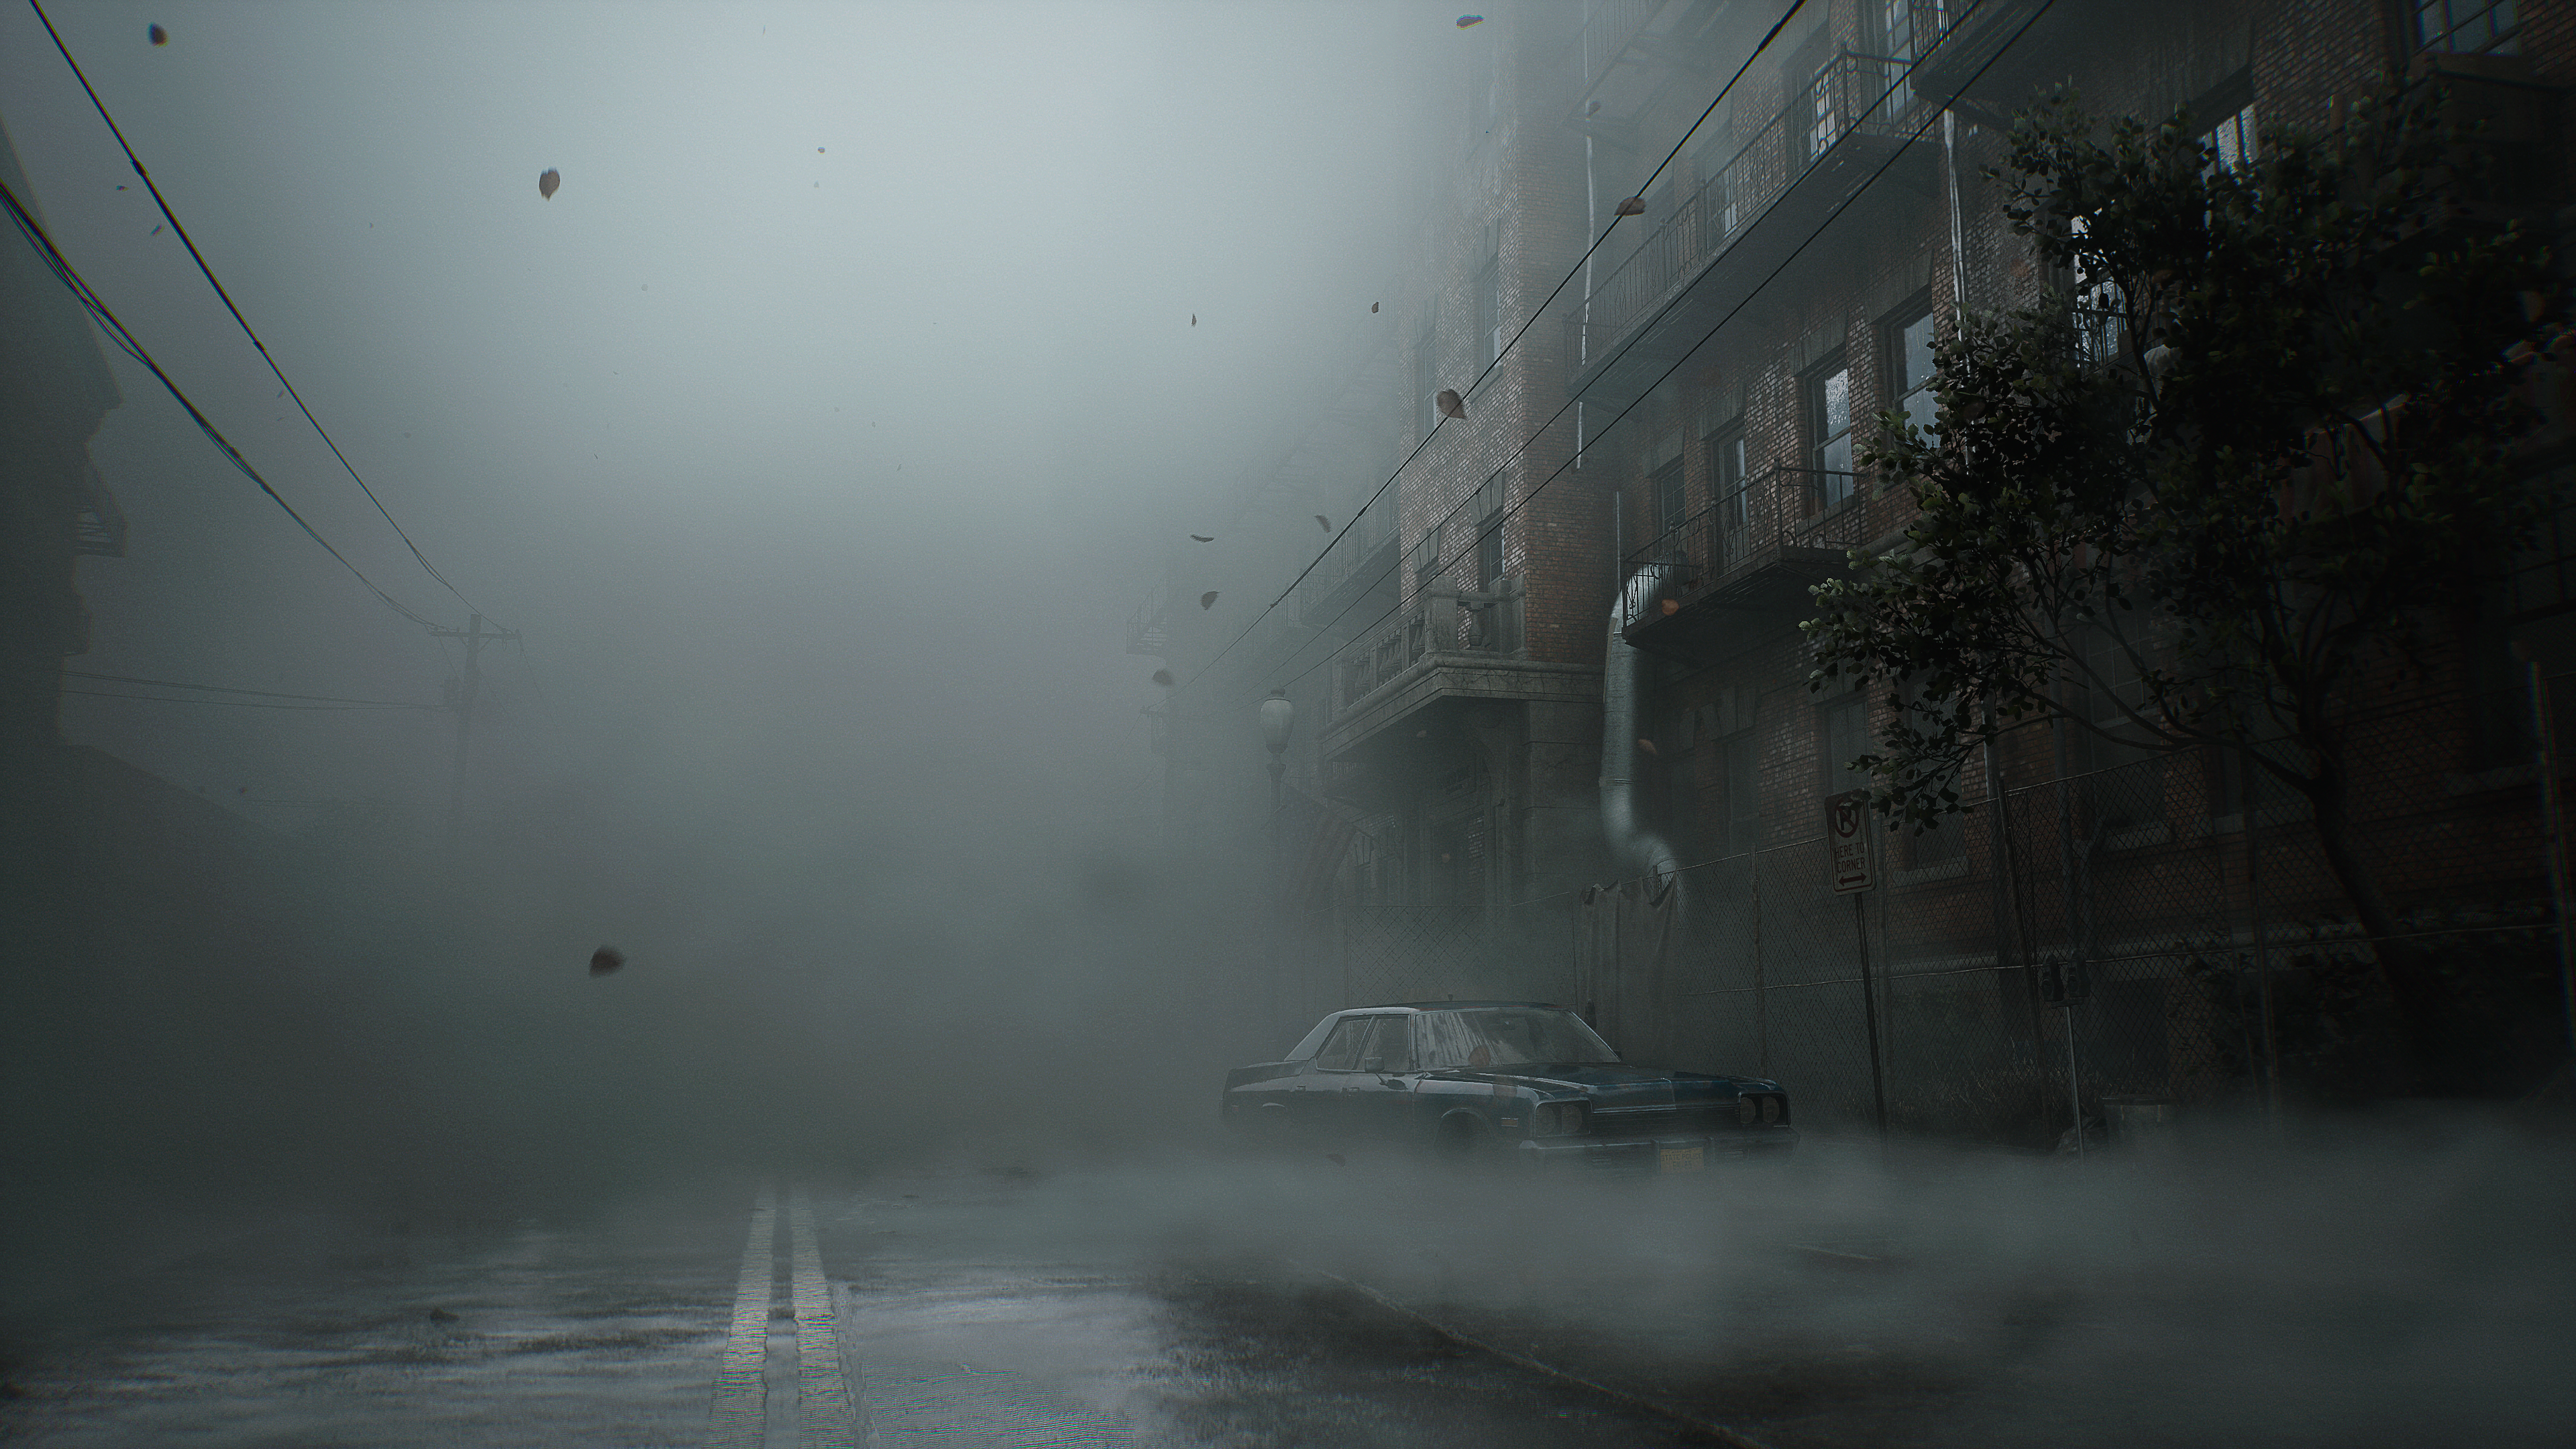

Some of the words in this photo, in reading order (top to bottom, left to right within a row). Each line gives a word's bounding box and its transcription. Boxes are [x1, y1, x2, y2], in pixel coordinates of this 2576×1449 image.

[1834, 844, 1854, 859] HERE
[1856, 841, 1865, 854] TO
[1837, 857, 1866, 873] CORNER
